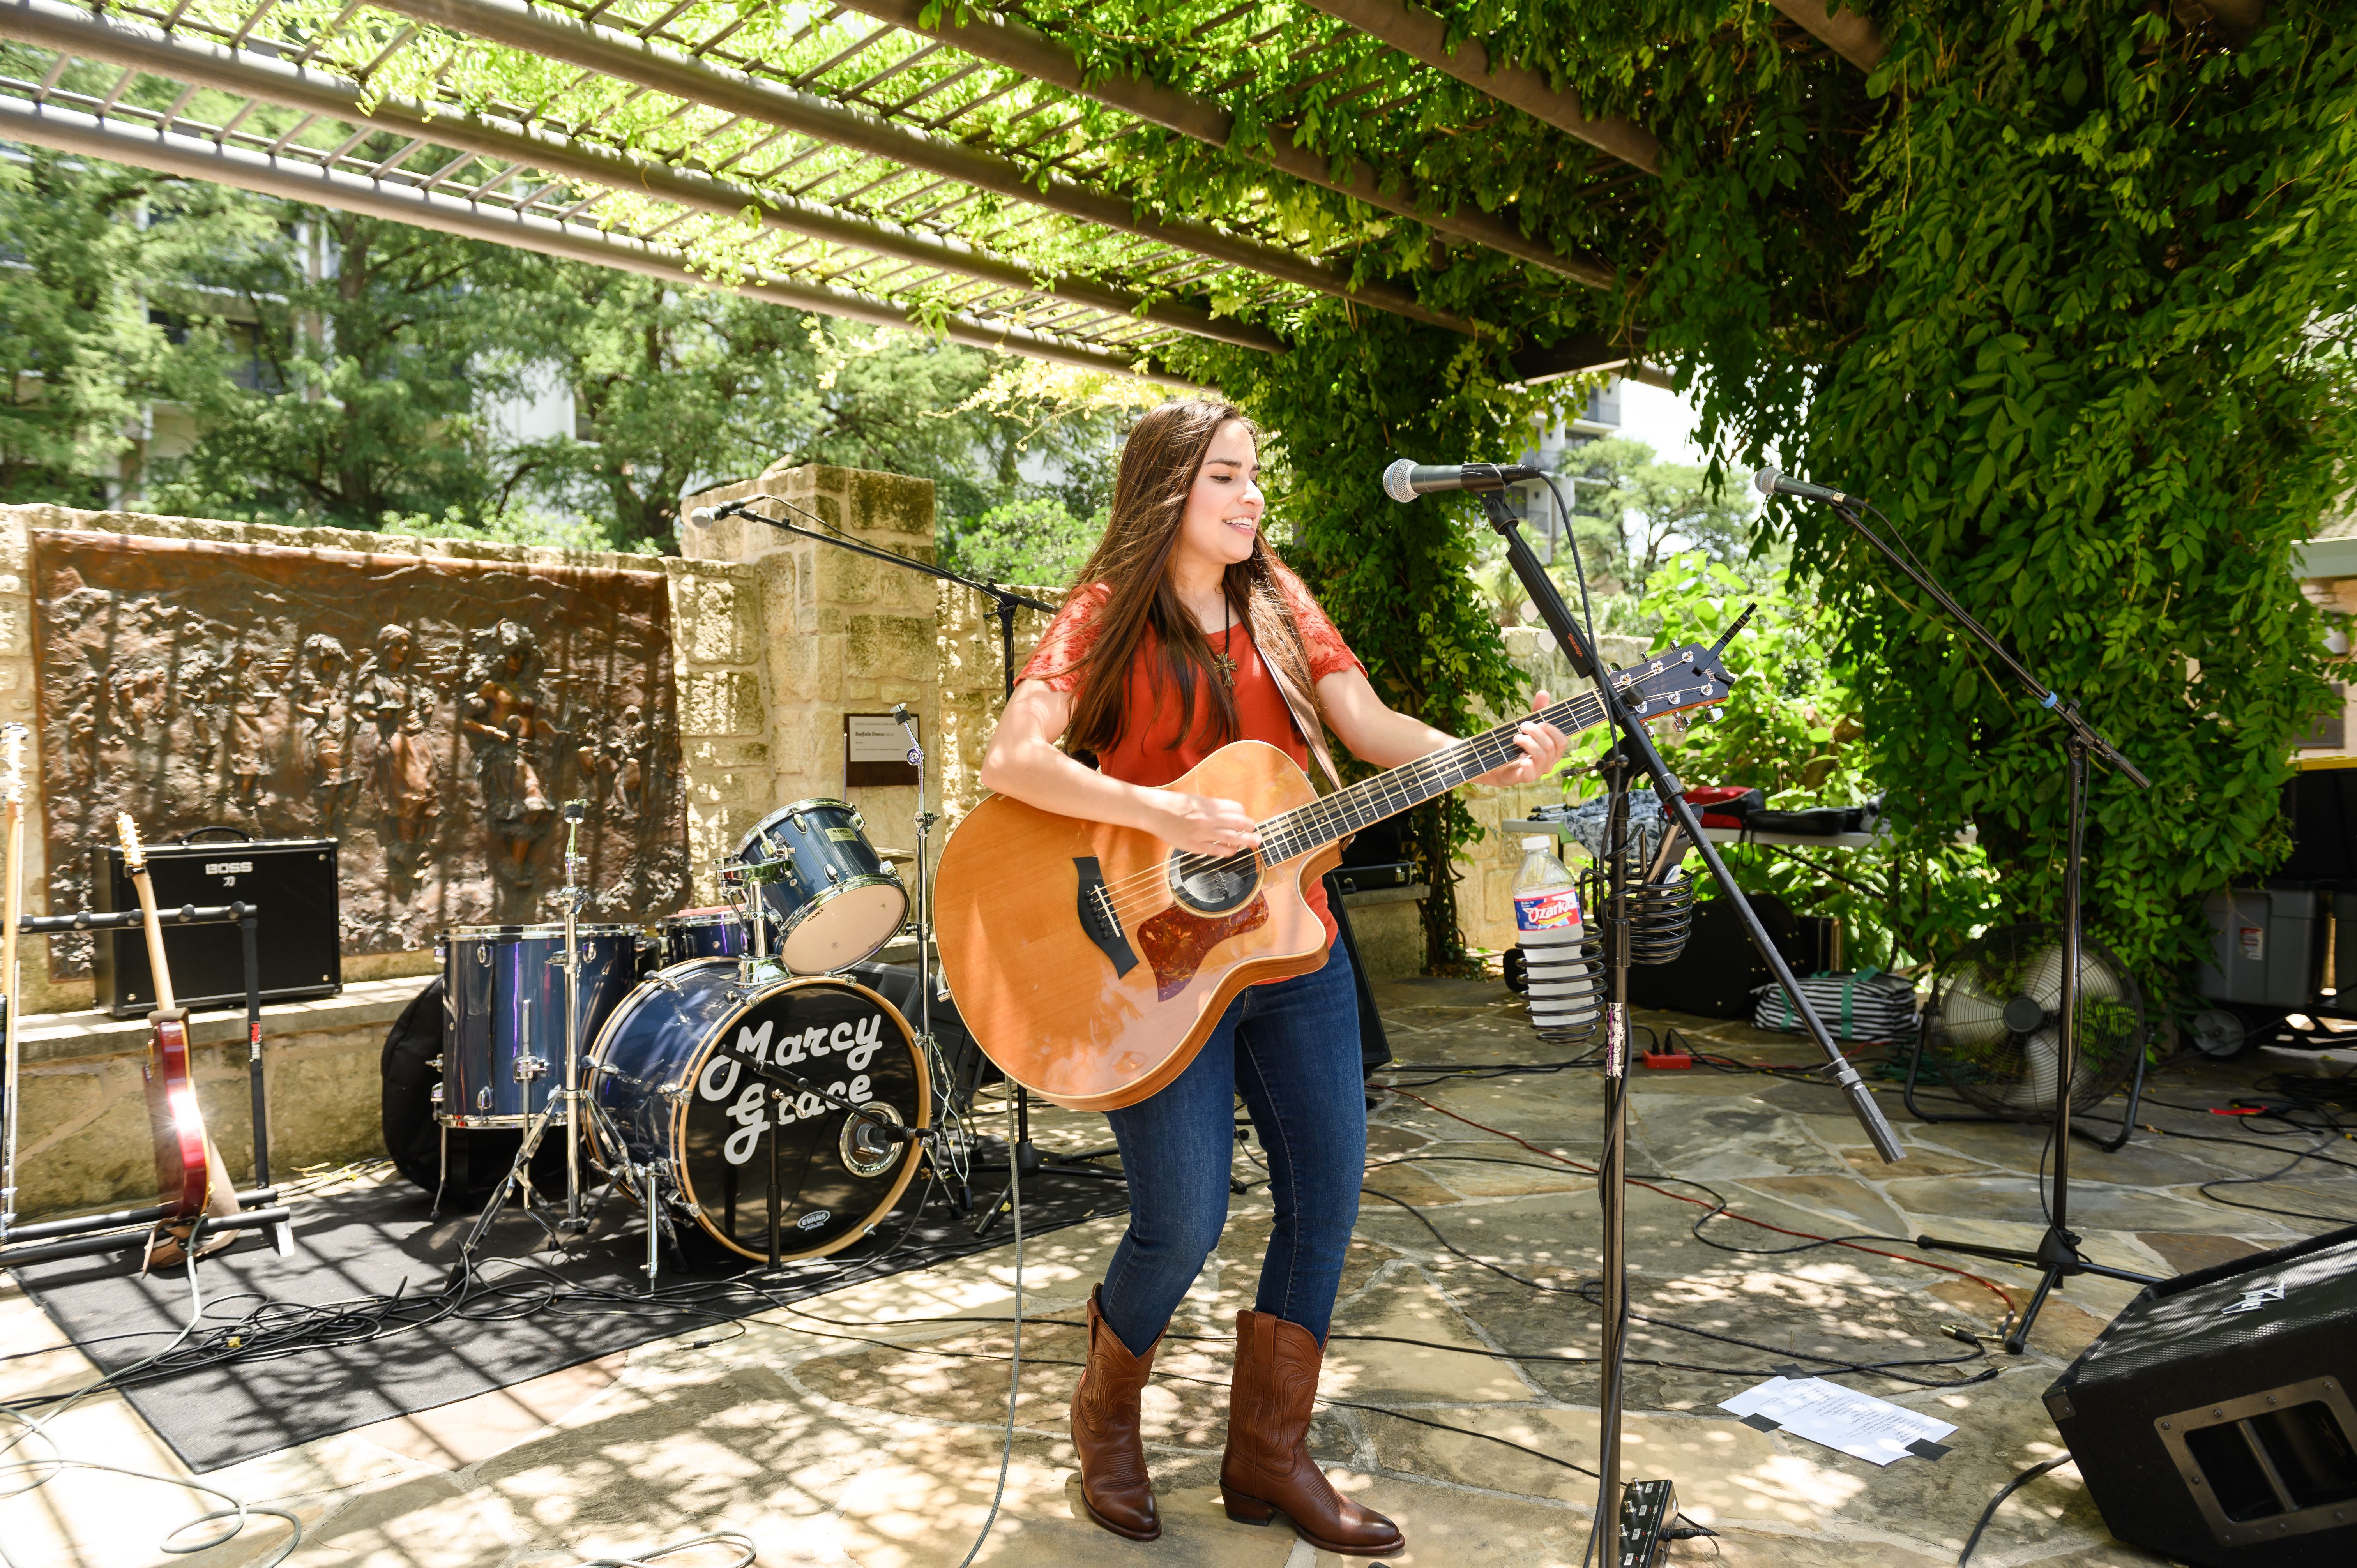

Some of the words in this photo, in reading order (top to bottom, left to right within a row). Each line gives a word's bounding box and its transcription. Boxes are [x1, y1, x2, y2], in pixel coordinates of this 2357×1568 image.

[205, 861, 253, 875] BOSS
[1528, 900, 1571, 923] Ozarka
[699, 1014, 883, 1101] Marcy
[724, 1074, 873, 1165] Grace
[801, 1213, 827, 1226] EVANS
